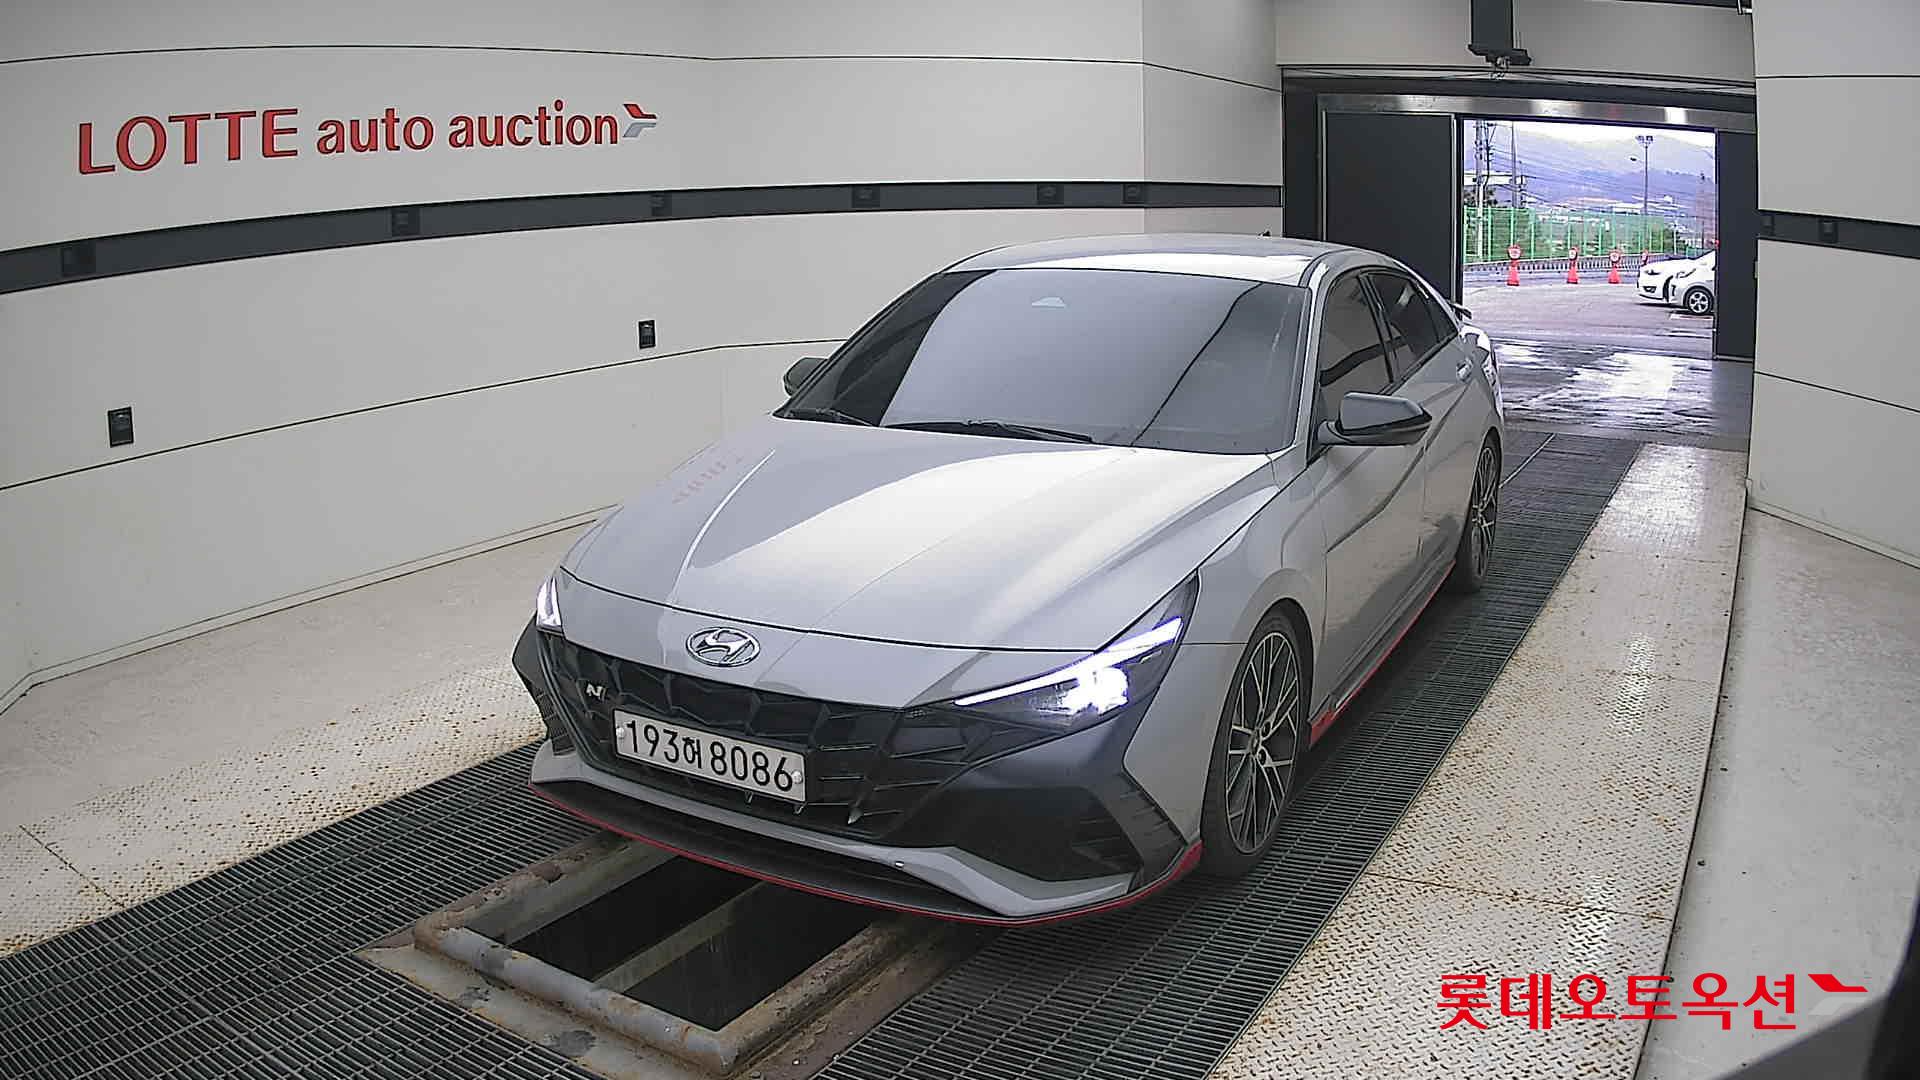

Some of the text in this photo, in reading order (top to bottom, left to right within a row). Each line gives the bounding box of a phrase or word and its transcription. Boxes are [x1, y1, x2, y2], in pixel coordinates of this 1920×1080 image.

[78, 99, 619, 175] LOTTE auto auction
